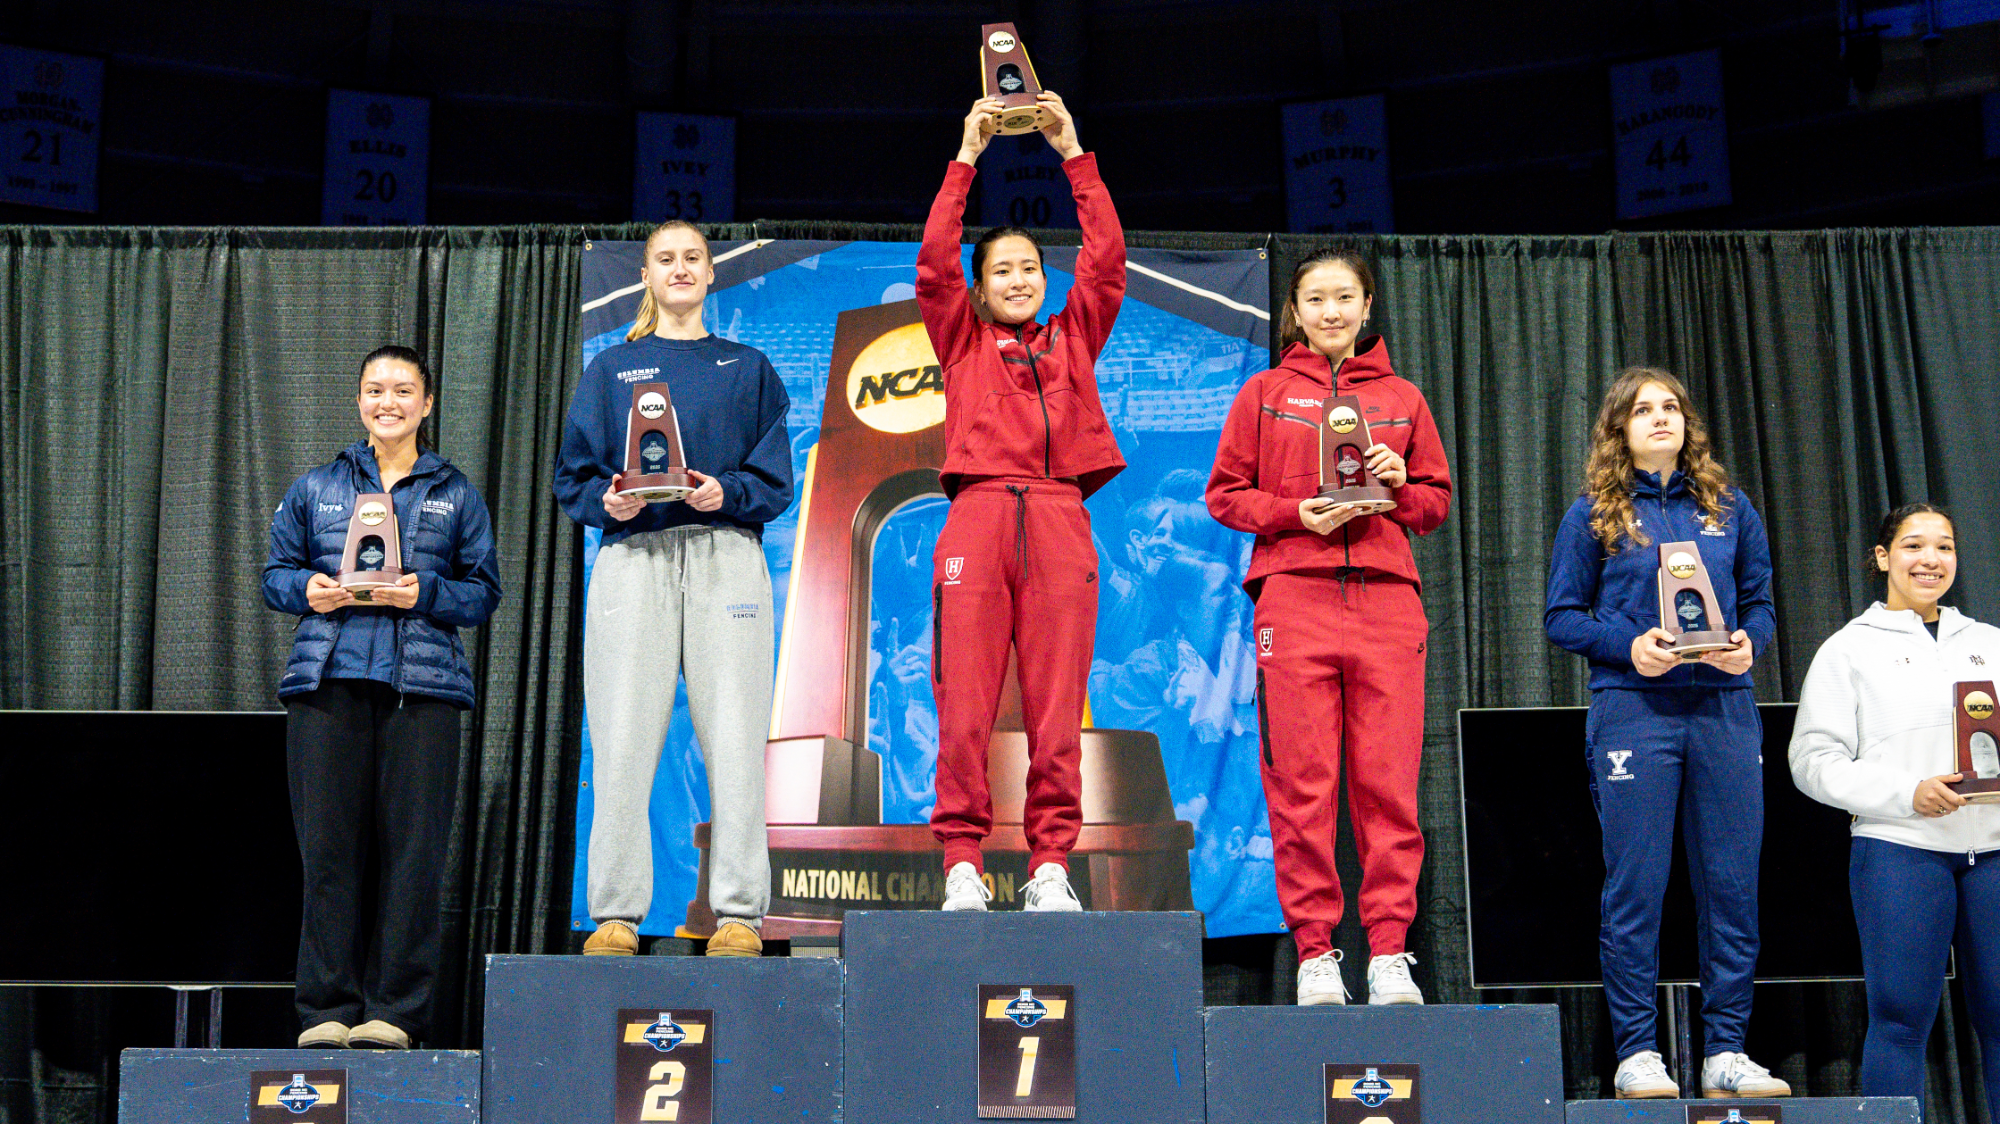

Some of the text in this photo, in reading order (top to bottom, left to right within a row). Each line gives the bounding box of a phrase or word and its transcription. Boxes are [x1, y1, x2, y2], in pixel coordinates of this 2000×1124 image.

[992, 39, 1014, 47] NCAA
[22, 130, 61, 166] 21
[1293, 145, 1380, 170] MURPHY
[1645, 136, 1692, 171] 44
[661, 160, 711, 177] IVEY
[355, 169, 397, 203] 20
[1328, 176, 1347, 209] 3
[665, 190, 703, 221] 33
[1010, 196, 1051, 227] 00
[855, 365, 944, 410] NCA
[641, 404, 666, 412] NCAA
[1332, 418, 1357, 427] NCAA
[318, 502, 336, 514] Ivy
[422, 507, 447, 515] ENCING
[1607, 750, 1633, 776] Y
[782, 868, 882, 901] NATIONAL
[644, 1032, 686, 1040] CHAMPIONSHIPS
[1015, 1036, 1040, 1097] 1
[641, 1061, 686, 1121] 2
